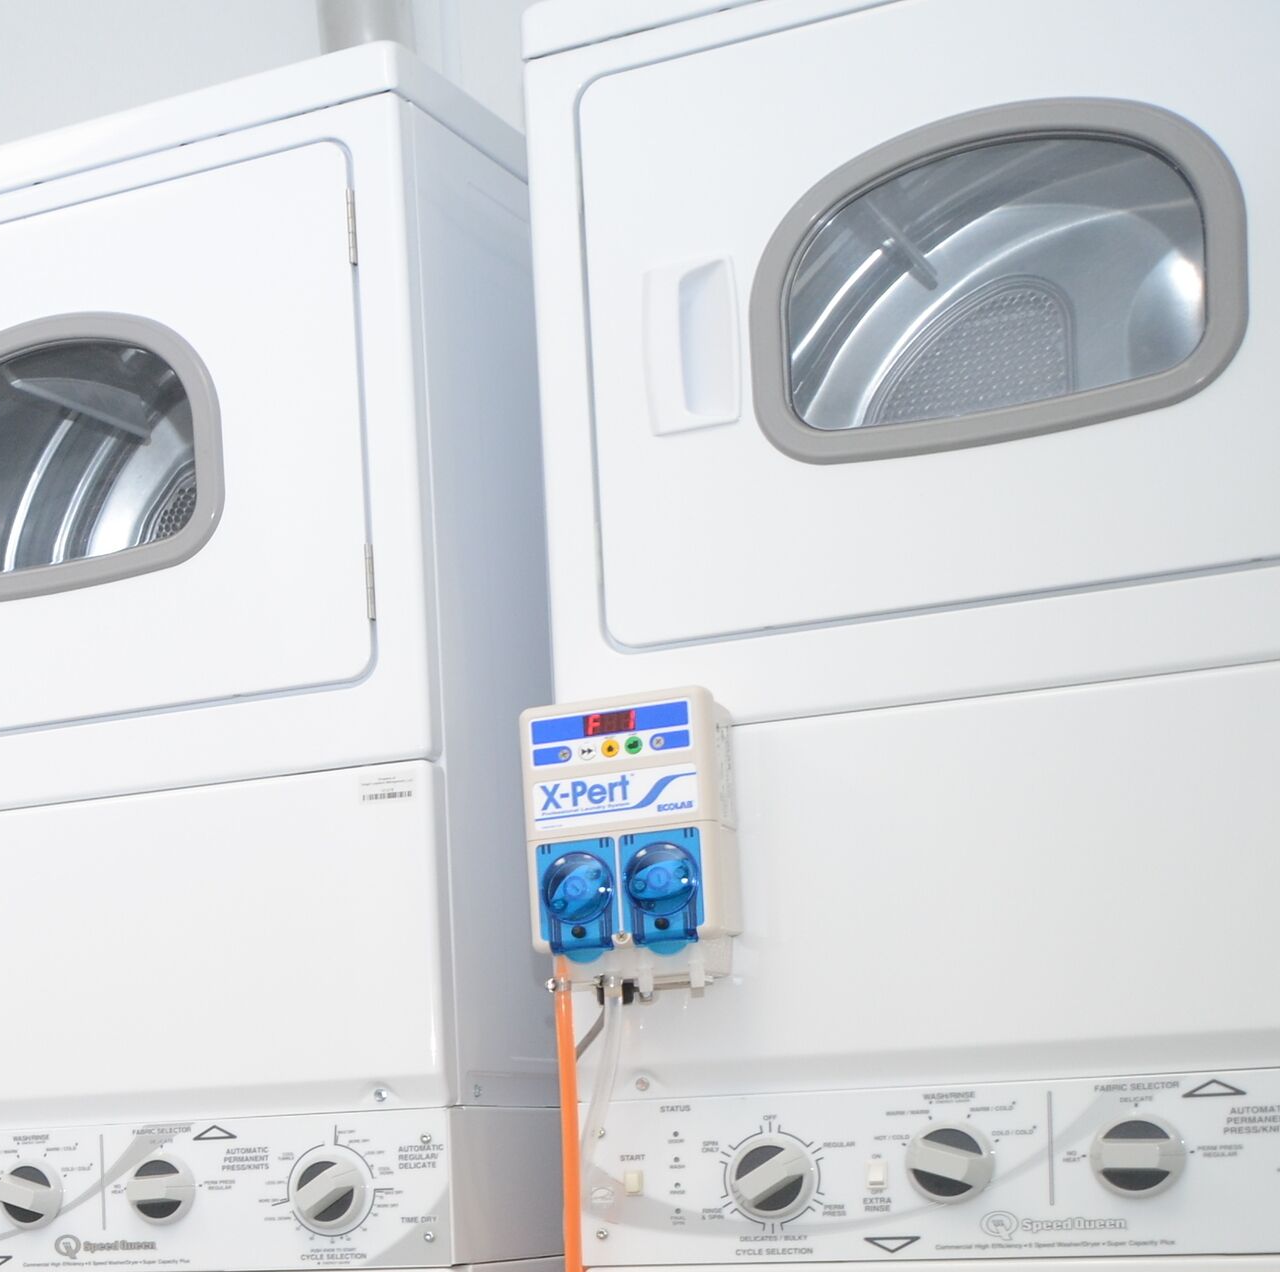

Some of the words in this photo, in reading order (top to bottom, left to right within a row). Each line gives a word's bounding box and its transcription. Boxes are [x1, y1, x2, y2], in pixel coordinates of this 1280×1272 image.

[540, 775, 630, 811] X-Pert
[657, 800, 694, 812] ECOLAB
[1094, 1083, 1128, 1093] FABRIC
[1130, 1081, 1180, 1091] SELECTOR
[660, 1105, 691, 1113] STATUS
[398, 1144, 444, 1152] AUTOMATIC
[620, 1154, 646, 1162] START
[221, 1163, 270, 1171] PRESS/KNITS
[398, 1162, 437, 1170] DELICATE
[862, 1197, 892, 1205] EXTRA
[1021, 1217, 1072, 1233] Speed
[1074, 1216, 1127, 1230] Queen
[83, 1240, 119, 1253] Speed
[765, 1248, 814, 1256] SELECTION
[300, 1253, 325, 1261] CYCLE
[326, 1252, 368, 1260] SELECTION
